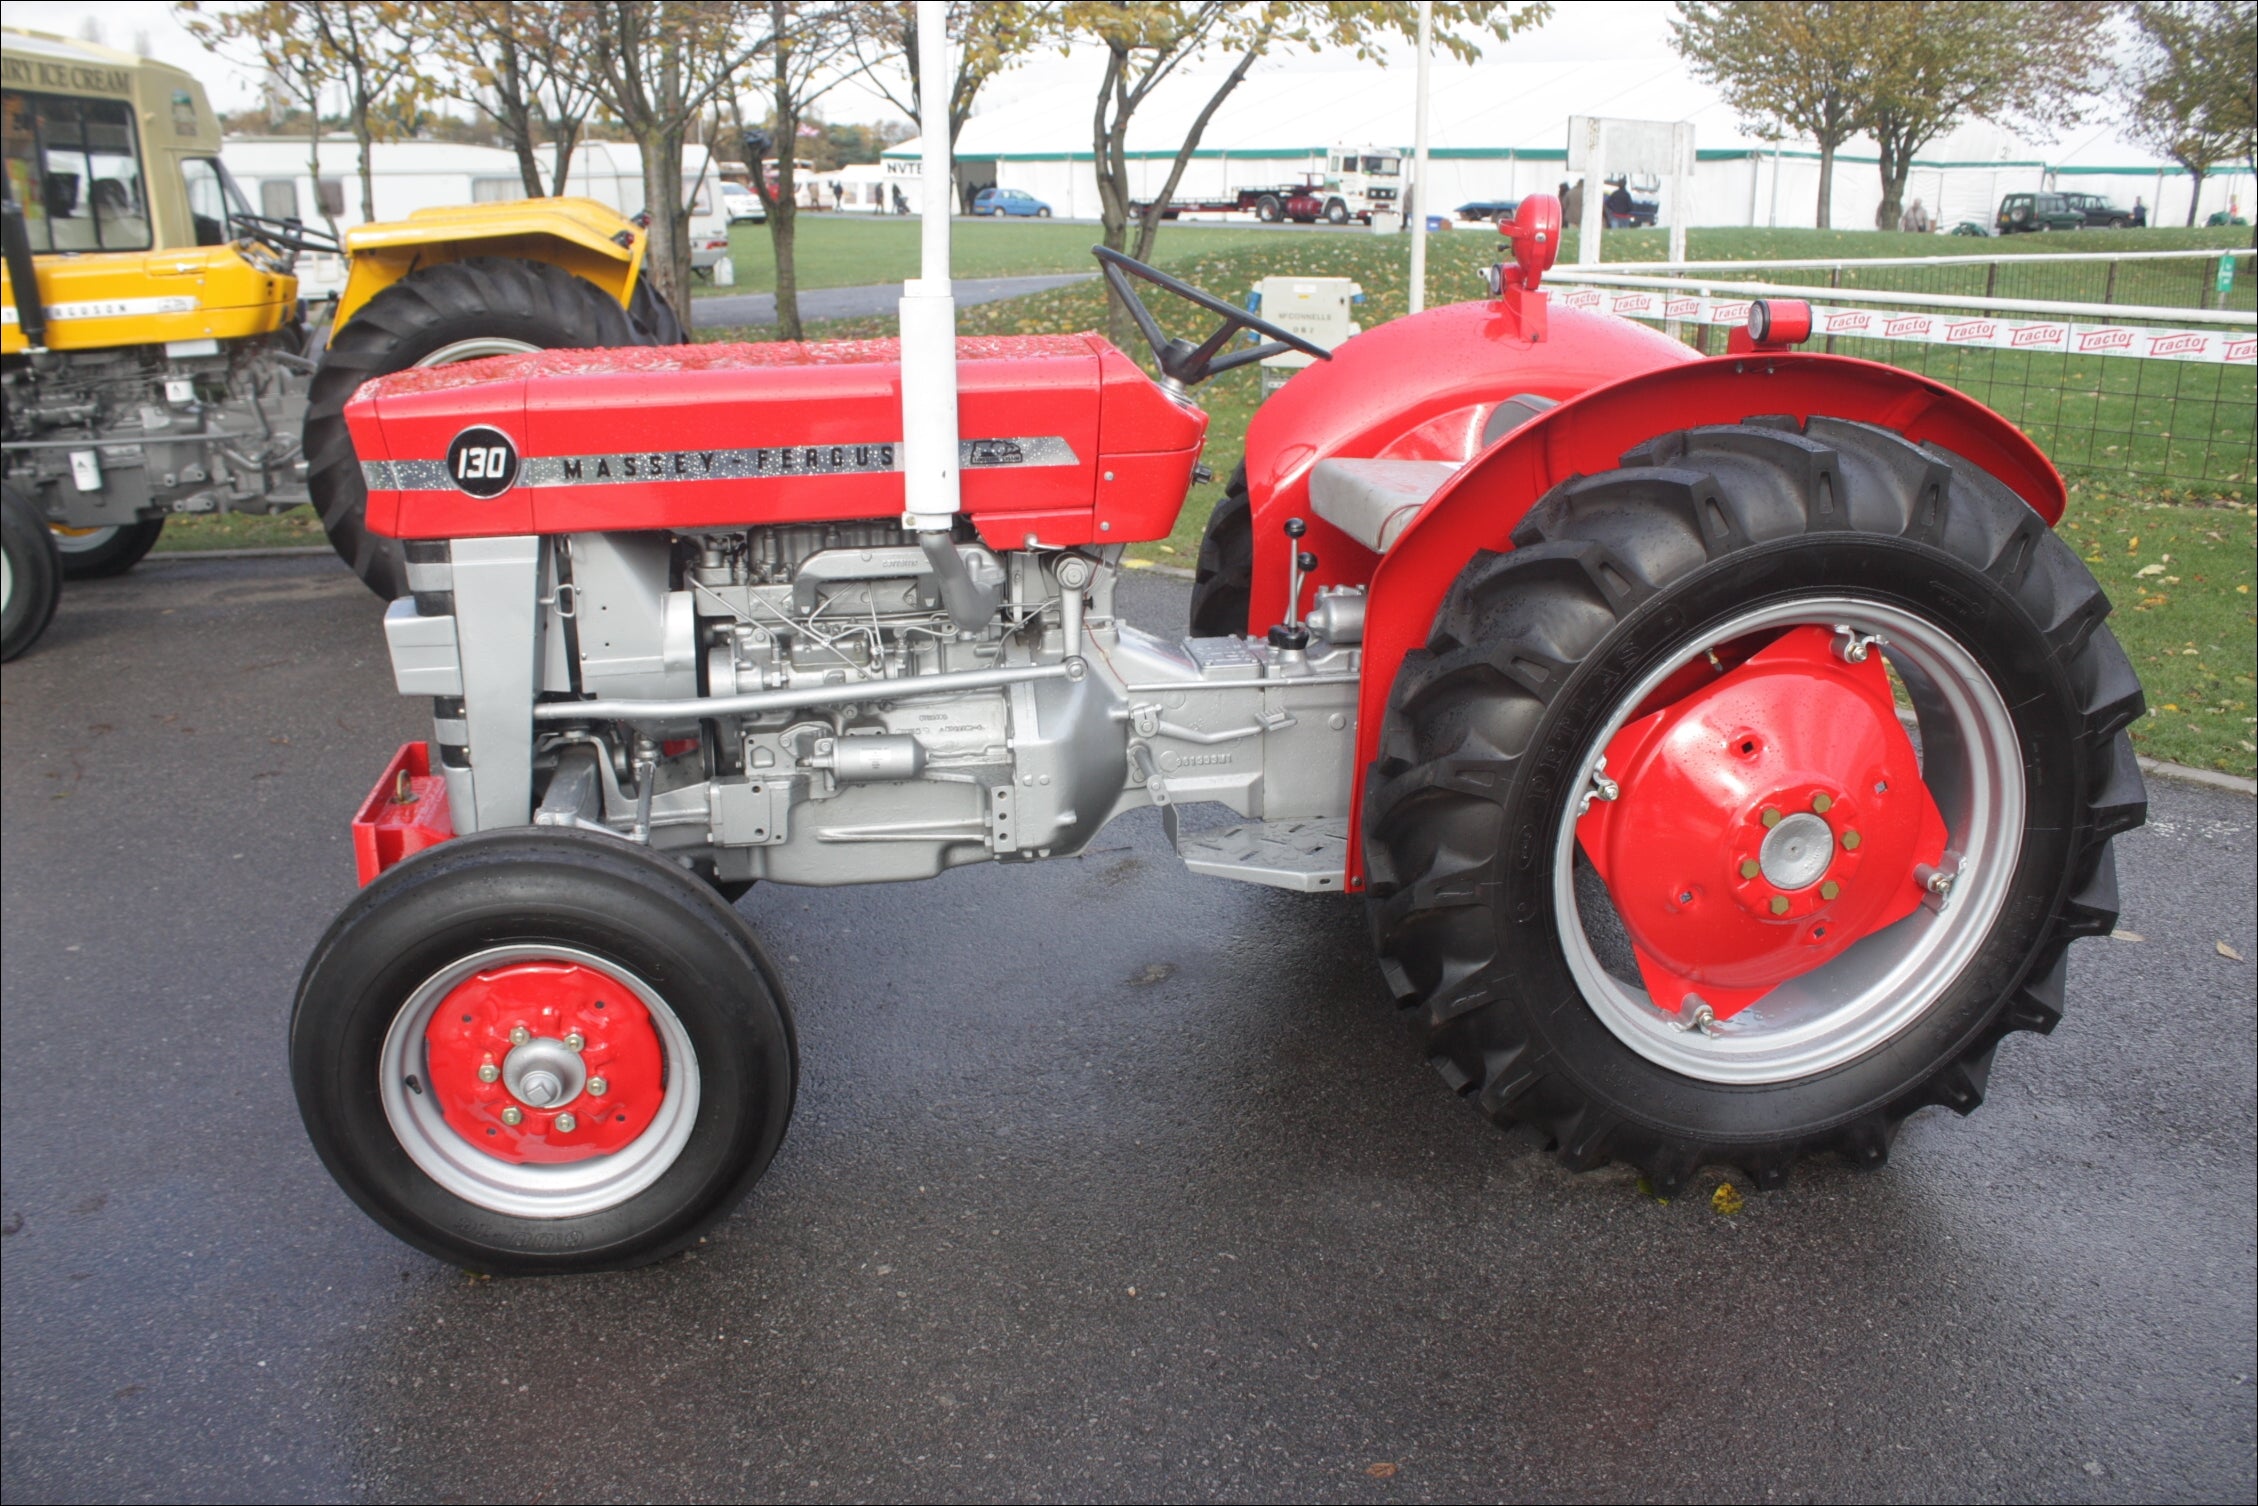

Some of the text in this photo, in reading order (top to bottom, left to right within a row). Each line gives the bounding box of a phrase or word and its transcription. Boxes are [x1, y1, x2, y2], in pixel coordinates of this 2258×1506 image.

[38, 62, 69, 88] ICE
[71, 66, 131, 94] CREAM
[1611, 294, 1651, 312] Tractor
[1662, 299, 1699, 317] Tractor
[1710, 303, 1750, 322] Tracto
[1824, 312, 1872, 331] Tractor
[1882, 316, 1932, 336] Tractor
[1944, 320, 1997, 341] Tractor
[2008, 324, 2064, 346] Tractor
[2076, 328, 2135, 351] Tractor
[2147, 333, 2209, 356] Tractor
[2222, 338, 2257, 361] Trac
[458, 447, 506, 479] 130
[564, 452, 714, 479] MASSEY
[757, 446, 894, 470] FERGUS
